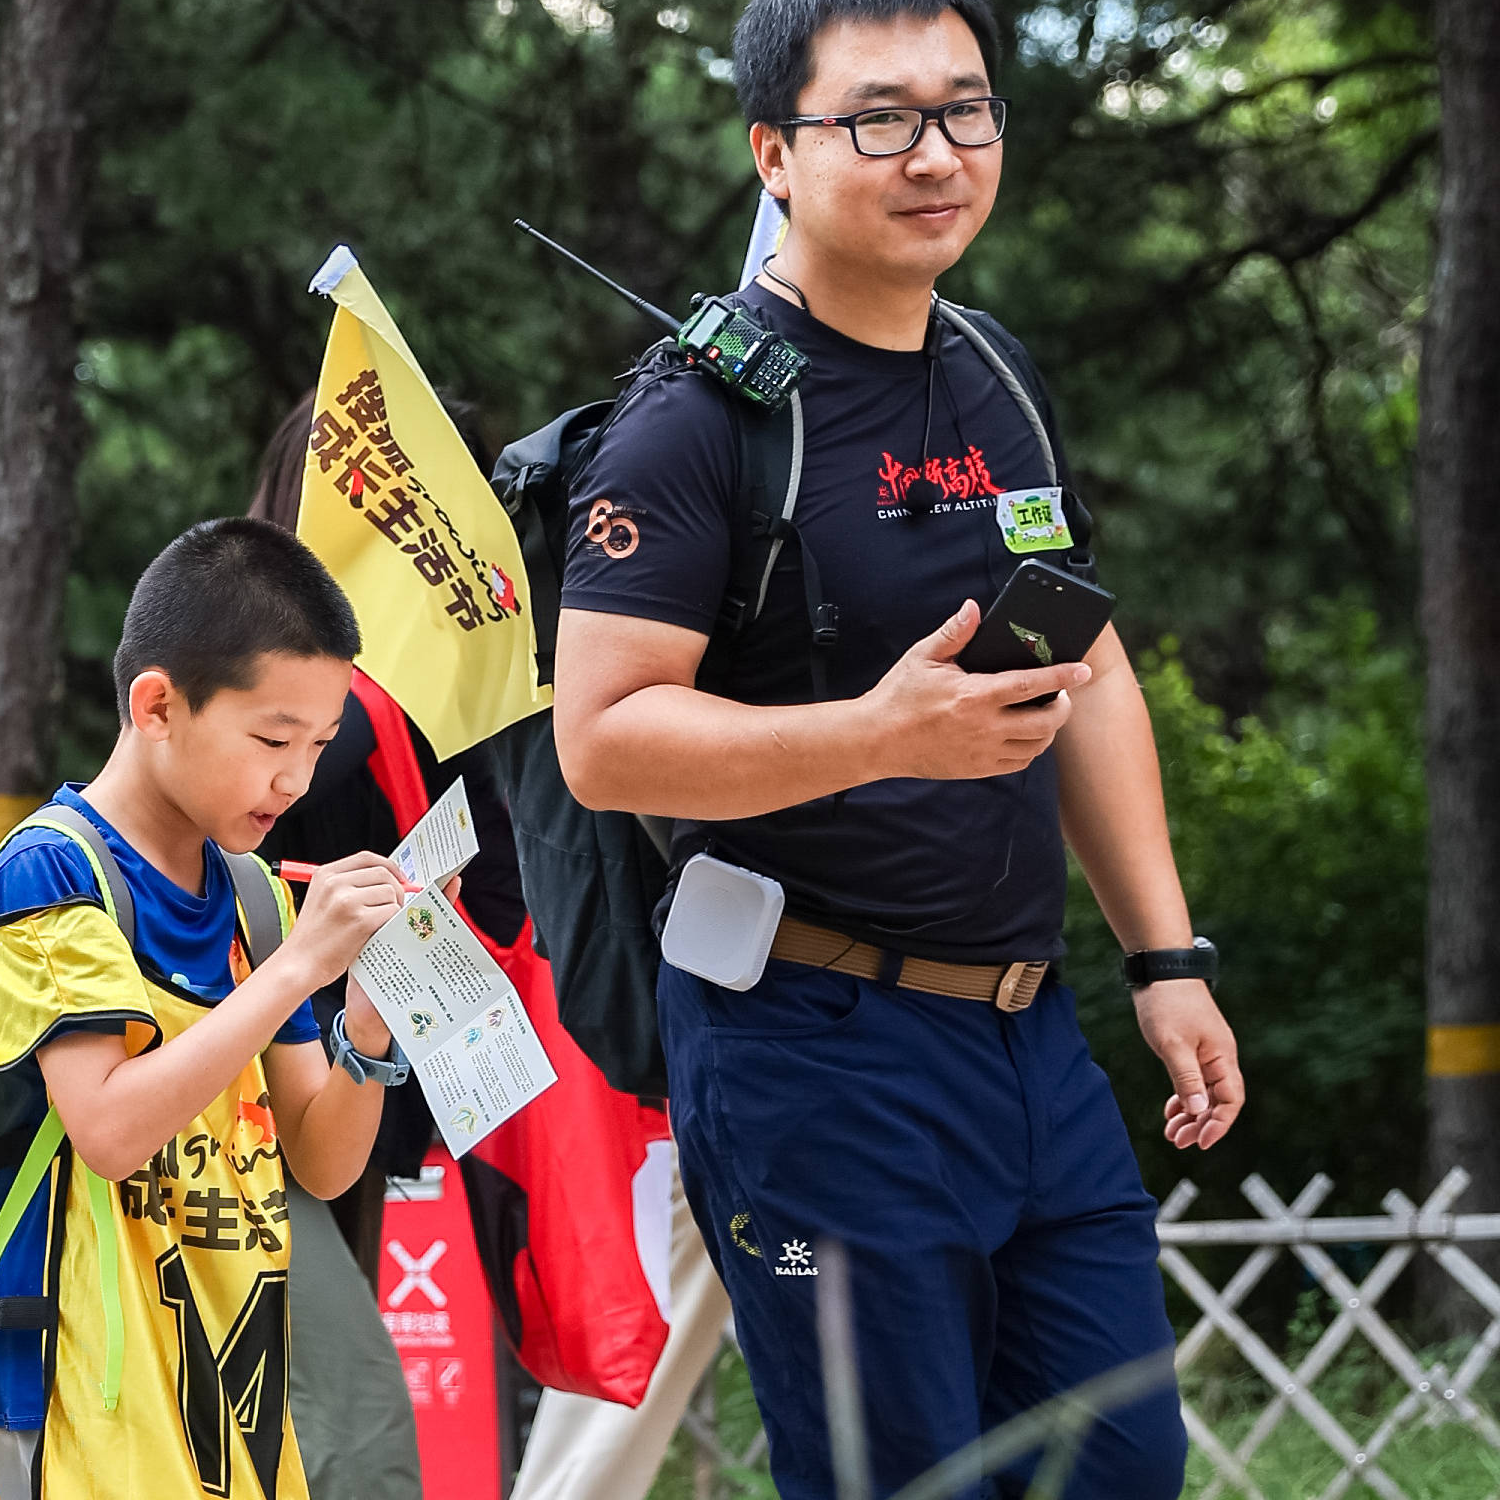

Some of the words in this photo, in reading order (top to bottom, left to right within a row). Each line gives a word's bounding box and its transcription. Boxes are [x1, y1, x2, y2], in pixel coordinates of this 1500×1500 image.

[878, 445, 1007, 500] 中新高度
[311, 409, 485, 632] 成长生活节
[929, 502, 952, 514] EW
[774, 1266, 820, 1277] KAILAS
